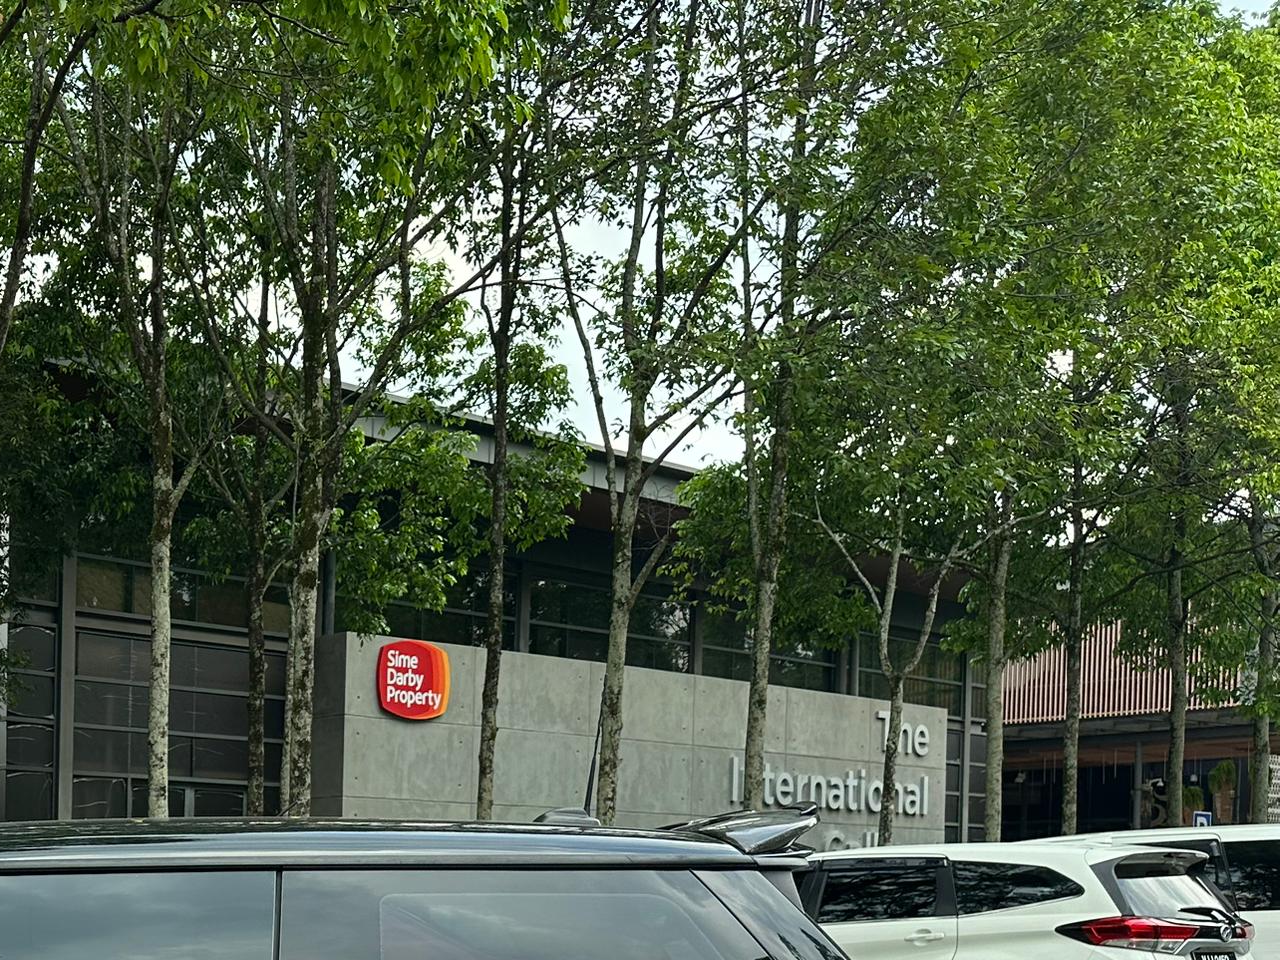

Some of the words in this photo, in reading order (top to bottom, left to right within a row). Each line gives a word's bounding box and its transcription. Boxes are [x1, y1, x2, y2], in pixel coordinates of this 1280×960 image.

[387, 649, 419, 669] Sime
[387, 668, 424, 691] Darby
[386, 685, 442, 710] Property
[730, 756, 929, 815] Iternational
